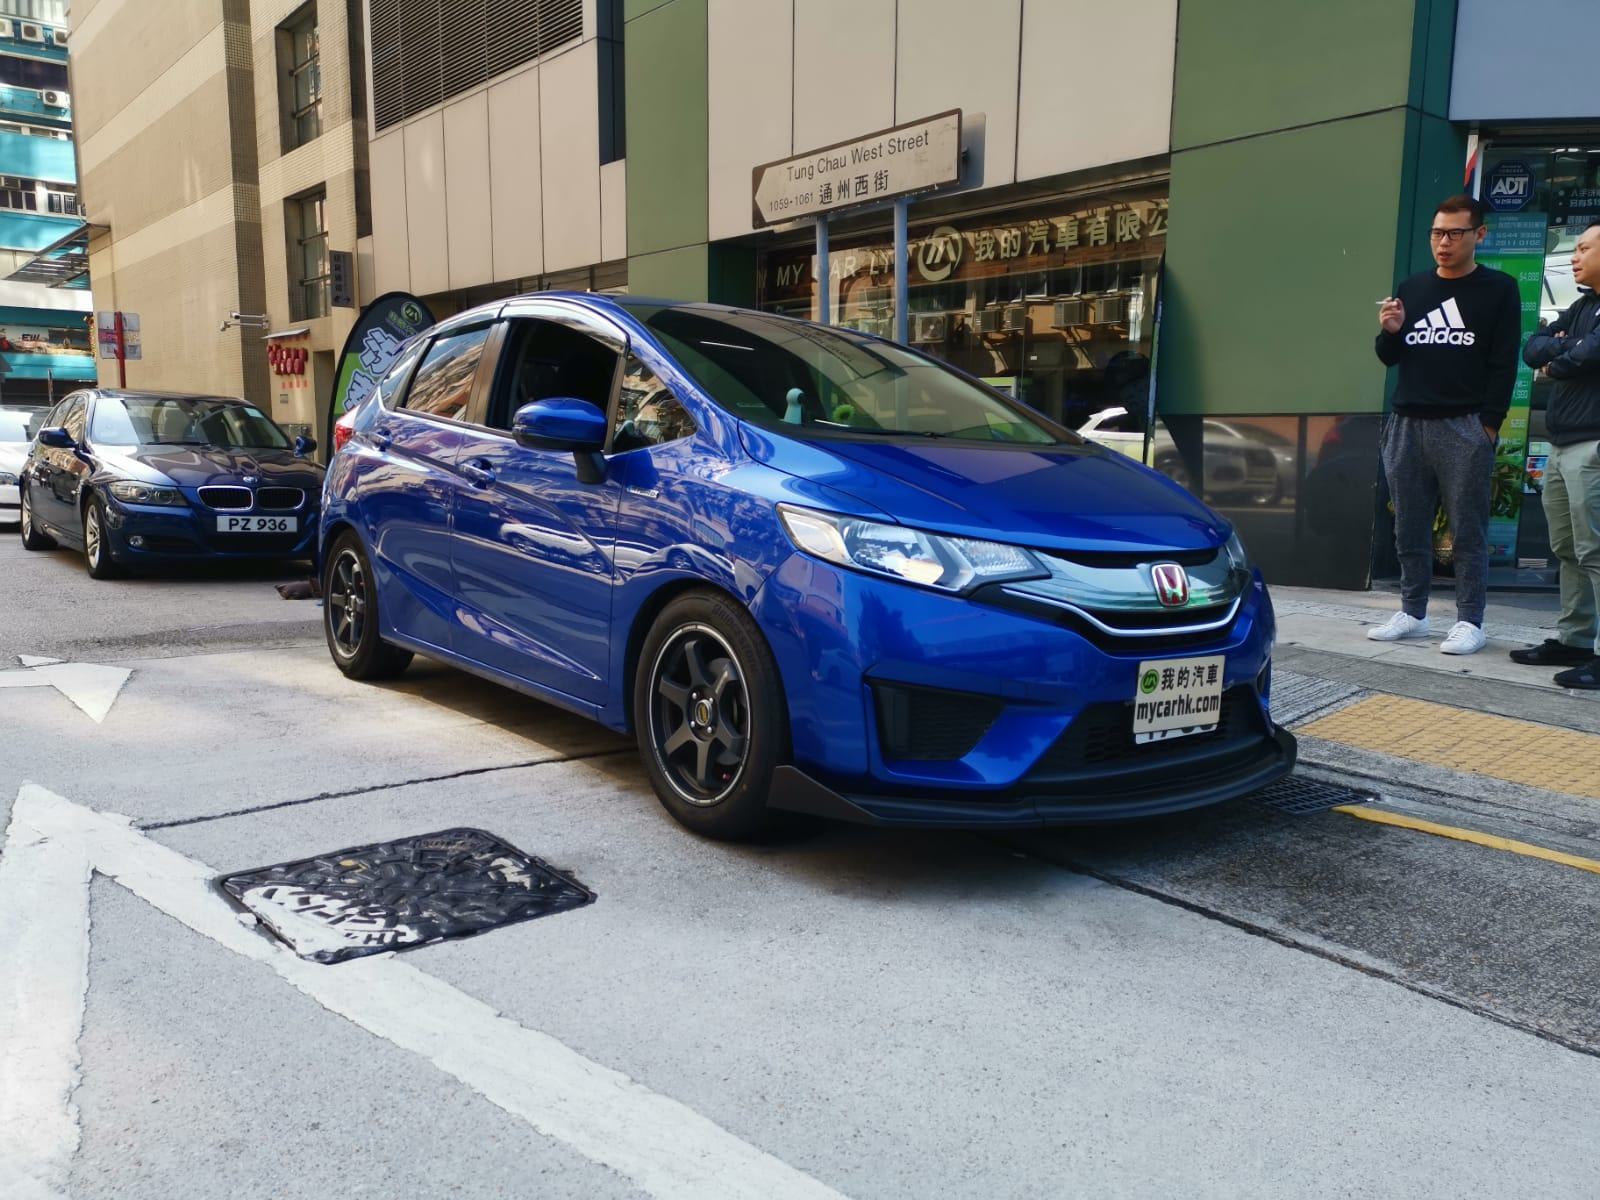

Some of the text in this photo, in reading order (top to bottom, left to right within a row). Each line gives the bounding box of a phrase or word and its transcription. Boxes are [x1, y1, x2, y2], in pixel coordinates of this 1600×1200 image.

[787, 130, 929, 181] Tung Chau West Street
[819, 169, 889, 205] 通州西街
[1491, 177, 1528, 195] ADT
[974, 208, 1168, 263] 我的汽車有限公
[776, 263, 804, 288] MY
[814, 256, 857, 280] AR
[1405, 327, 1475, 346] adidas
[228, 518, 287, 531] PZ 936
[1161, 664, 1219, 691] 我的汽車
[1136, 694, 1219, 724] mycarhk.com
